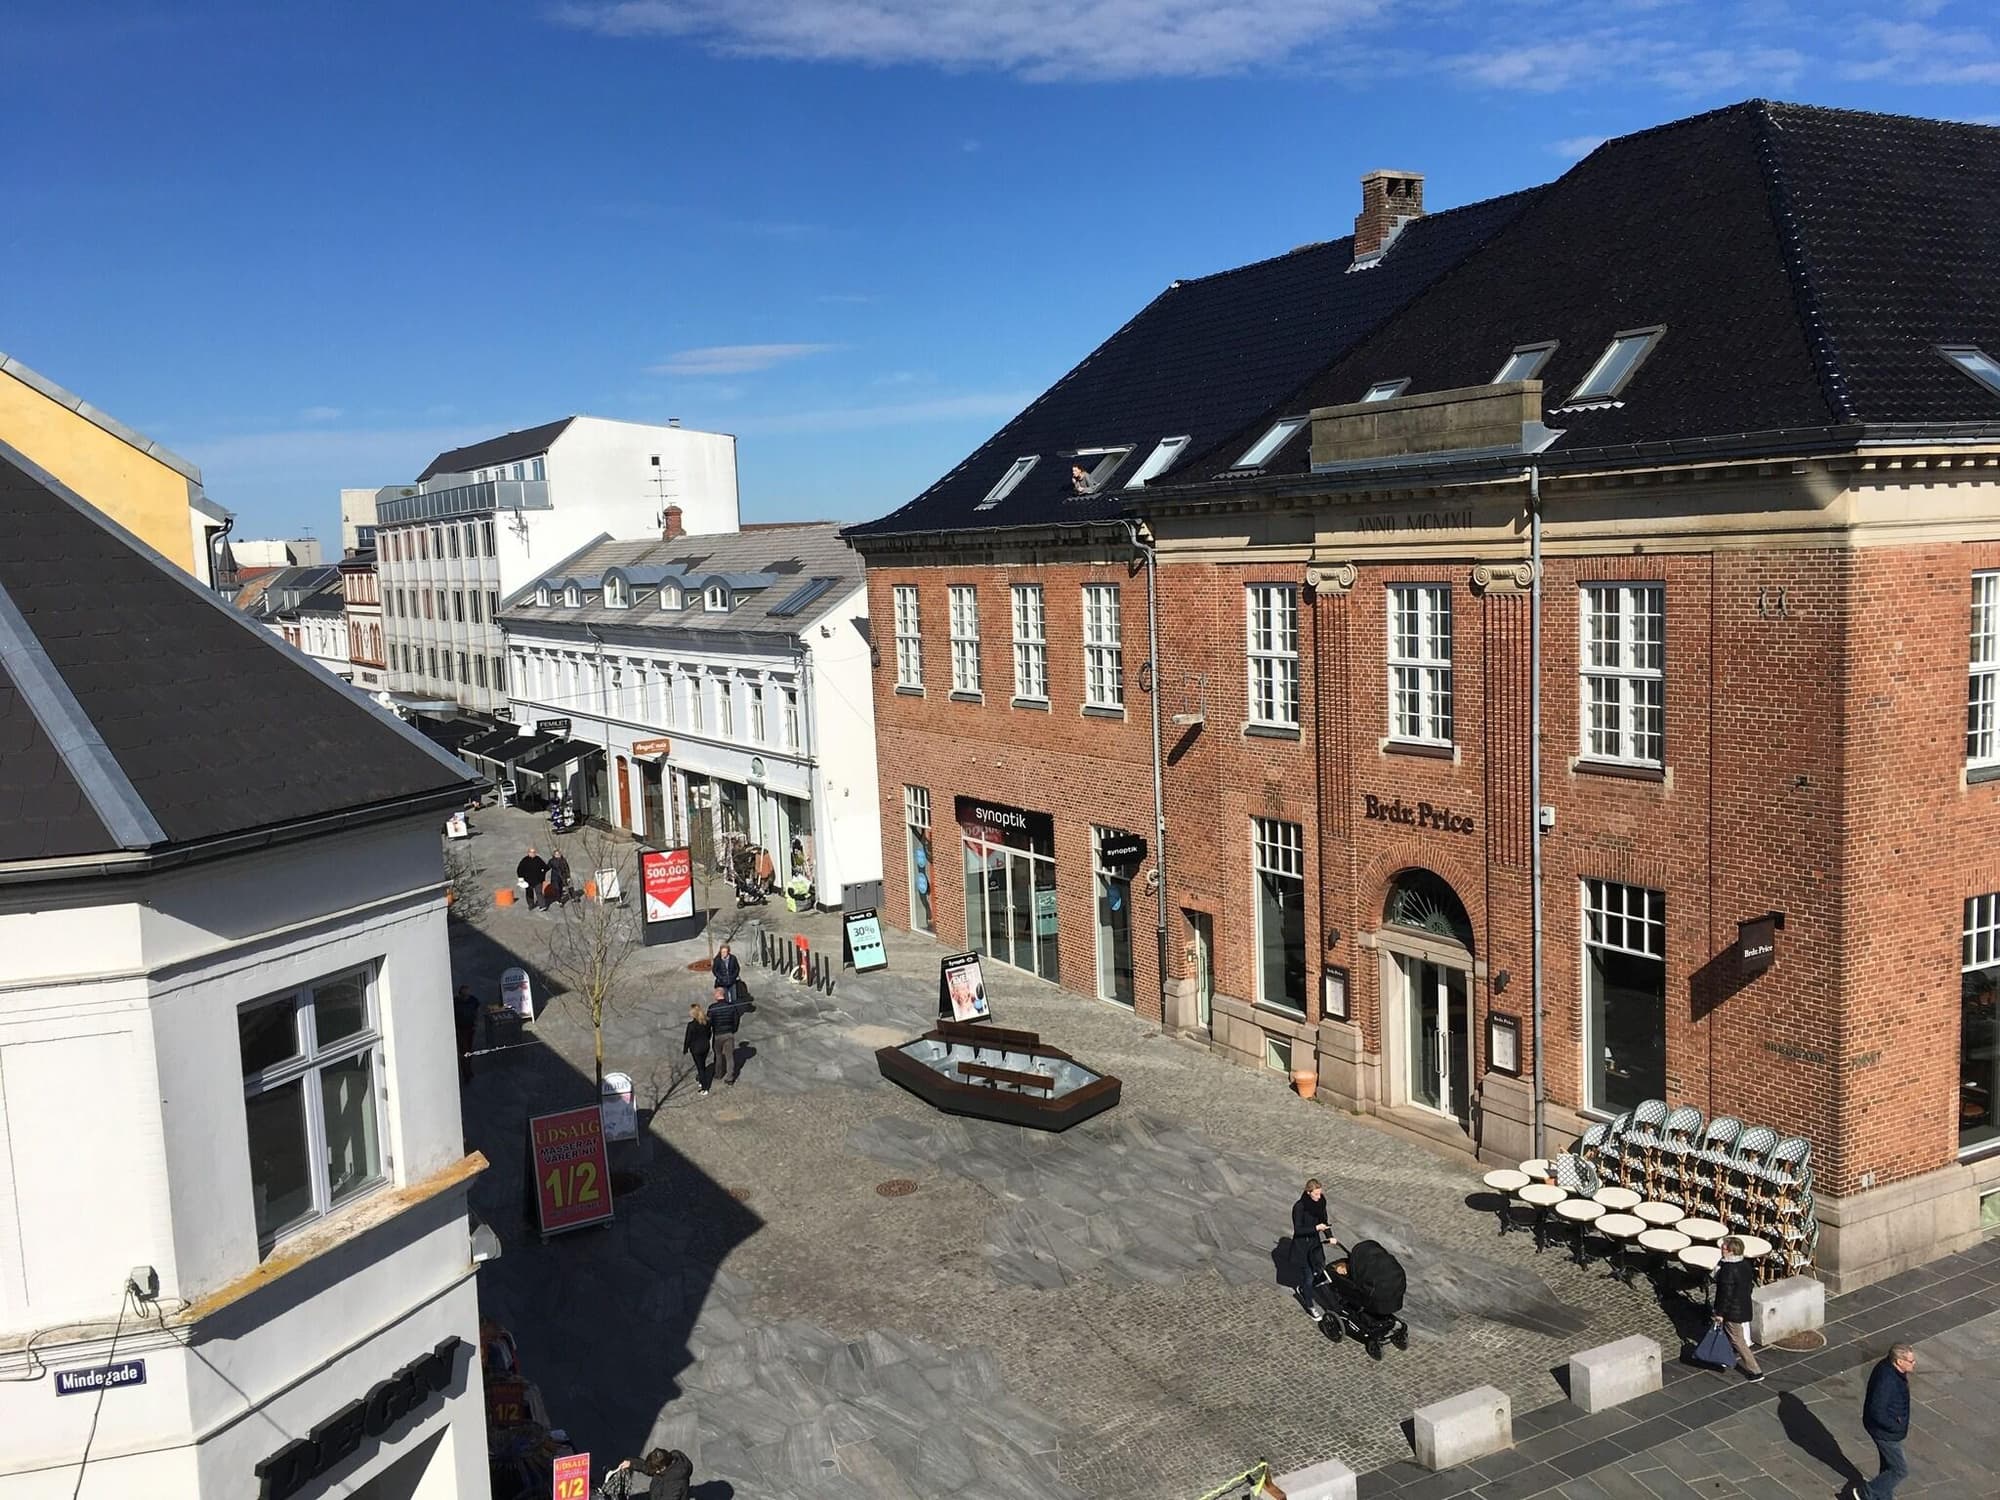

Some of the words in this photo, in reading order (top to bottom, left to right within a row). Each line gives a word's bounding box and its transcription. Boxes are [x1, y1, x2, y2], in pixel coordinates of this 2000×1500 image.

[1358, 515, 1396, 535] ANNO
[1406, 511, 1472, 534] MCMXII
[975, 807, 1027, 829] synoptik
[1364, 794, 1416, 826] Brdr.
[1418, 802, 1475, 835] Price
[1106, 846, 1138, 857] synoptik
[647, 865, 689, 879] 500.000
[853, 926, 875, 937] 30%
[1759, 944, 1774, 954] Price
[536, 1119, 600, 1144] UDSALG
[541, 1141, 583, 1156] MASSER
[544, 1150, 579, 1164] VARER
[581, 1146, 597, 1157] NU
[545, 1162, 600, 1208] 1/2
[62, 1365, 138, 1390] Mindegade
[559, 1477, 585, 1499] 1/2
